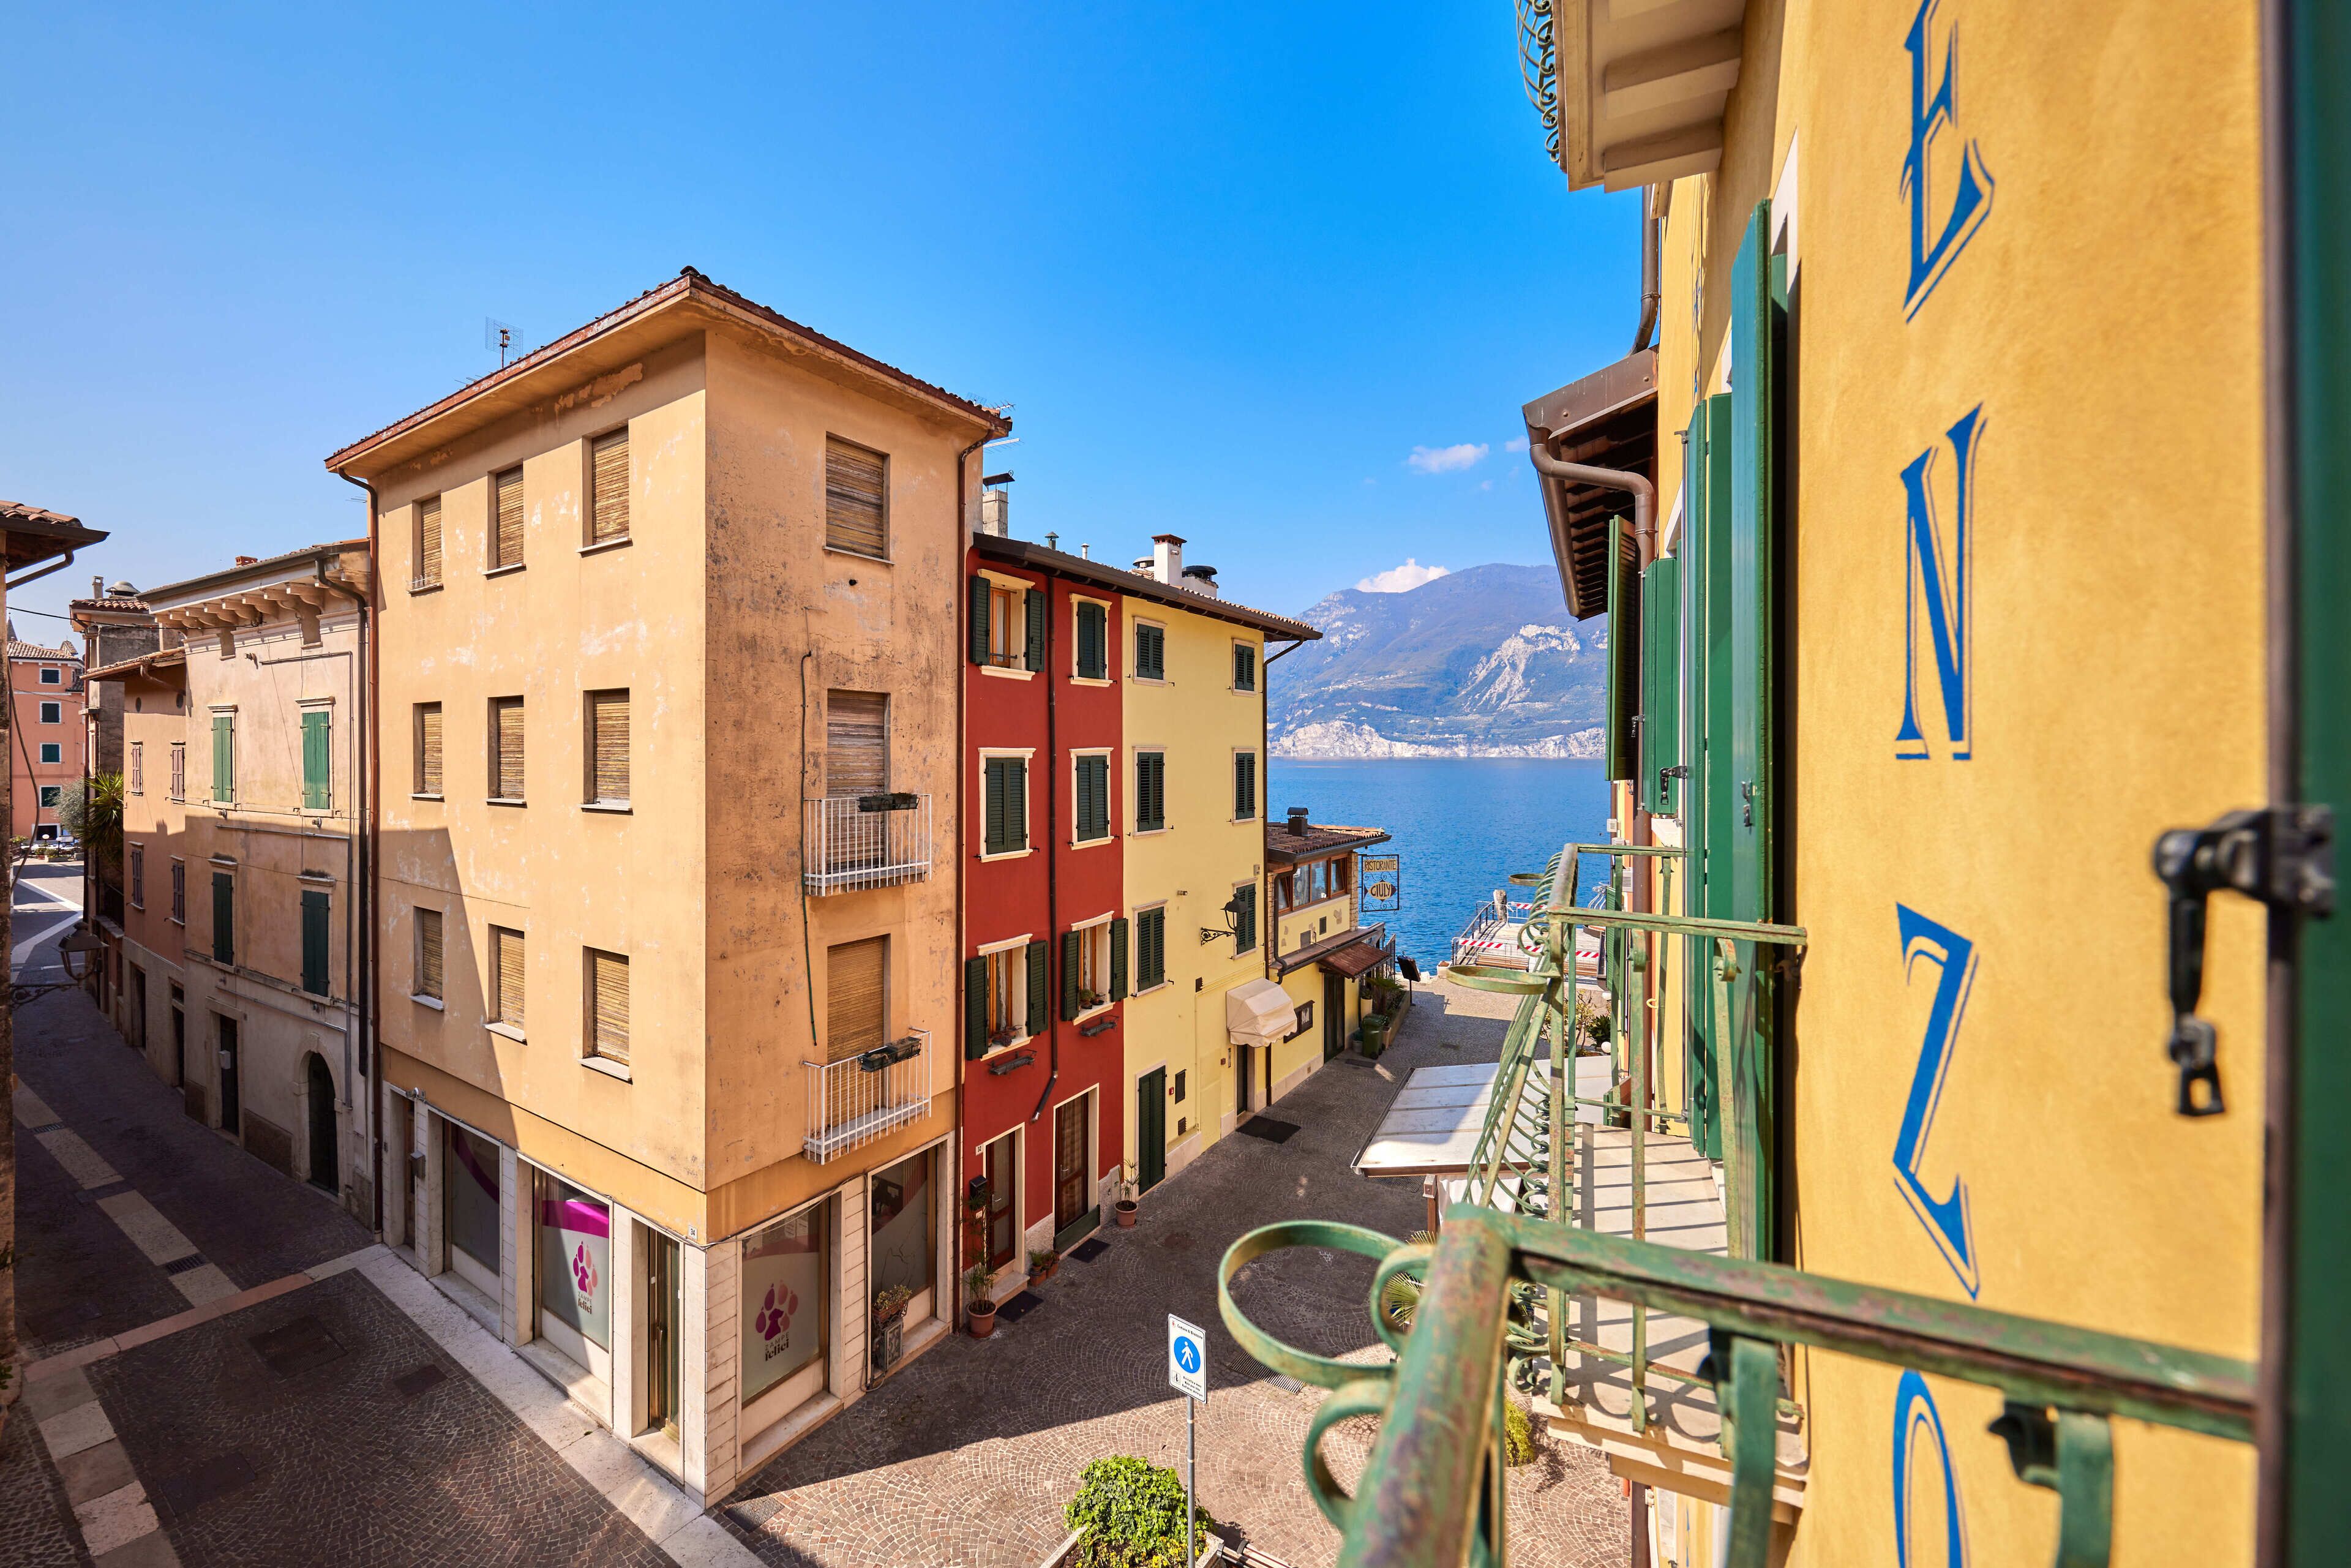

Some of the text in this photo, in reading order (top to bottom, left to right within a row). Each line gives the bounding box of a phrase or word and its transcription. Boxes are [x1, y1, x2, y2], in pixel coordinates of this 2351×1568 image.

[1365, 860, 1397, 871] RISTORANTE
[1370, 883, 1391, 897] GIULY
[577, 1291, 592, 1305] ZAMPE
[578, 1298, 592, 1315] felici
[765, 1332, 789, 1351] ZAMPE
[765, 1338, 789, 1362] felici
